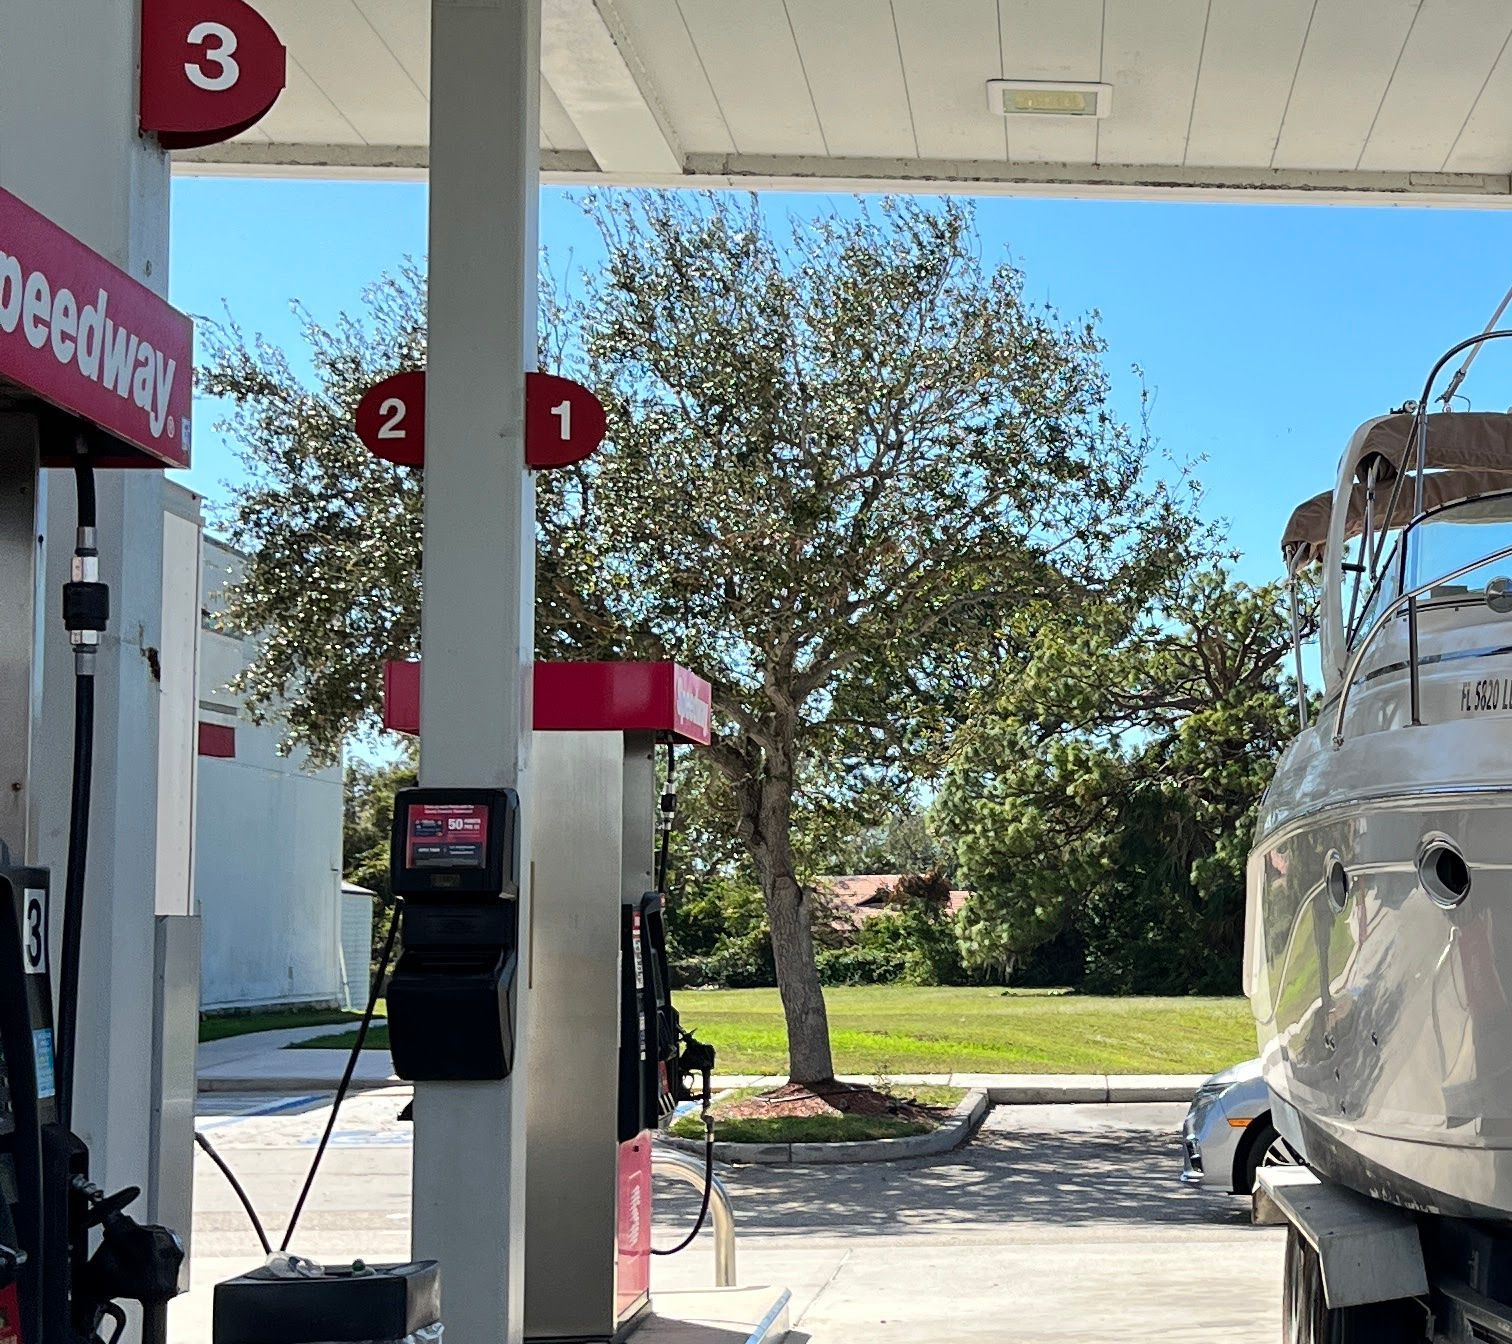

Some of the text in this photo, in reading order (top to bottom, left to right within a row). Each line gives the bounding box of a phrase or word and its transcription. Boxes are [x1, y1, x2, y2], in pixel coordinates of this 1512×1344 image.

[184, 21, 240, 91] 3
[0, 250, 176, 438] peedway
[377, 398, 407, 439] 2
[550, 400, 571, 441] 1
[1460, 681, 1471, 711] FL
[26, 898, 42, 967] 3
